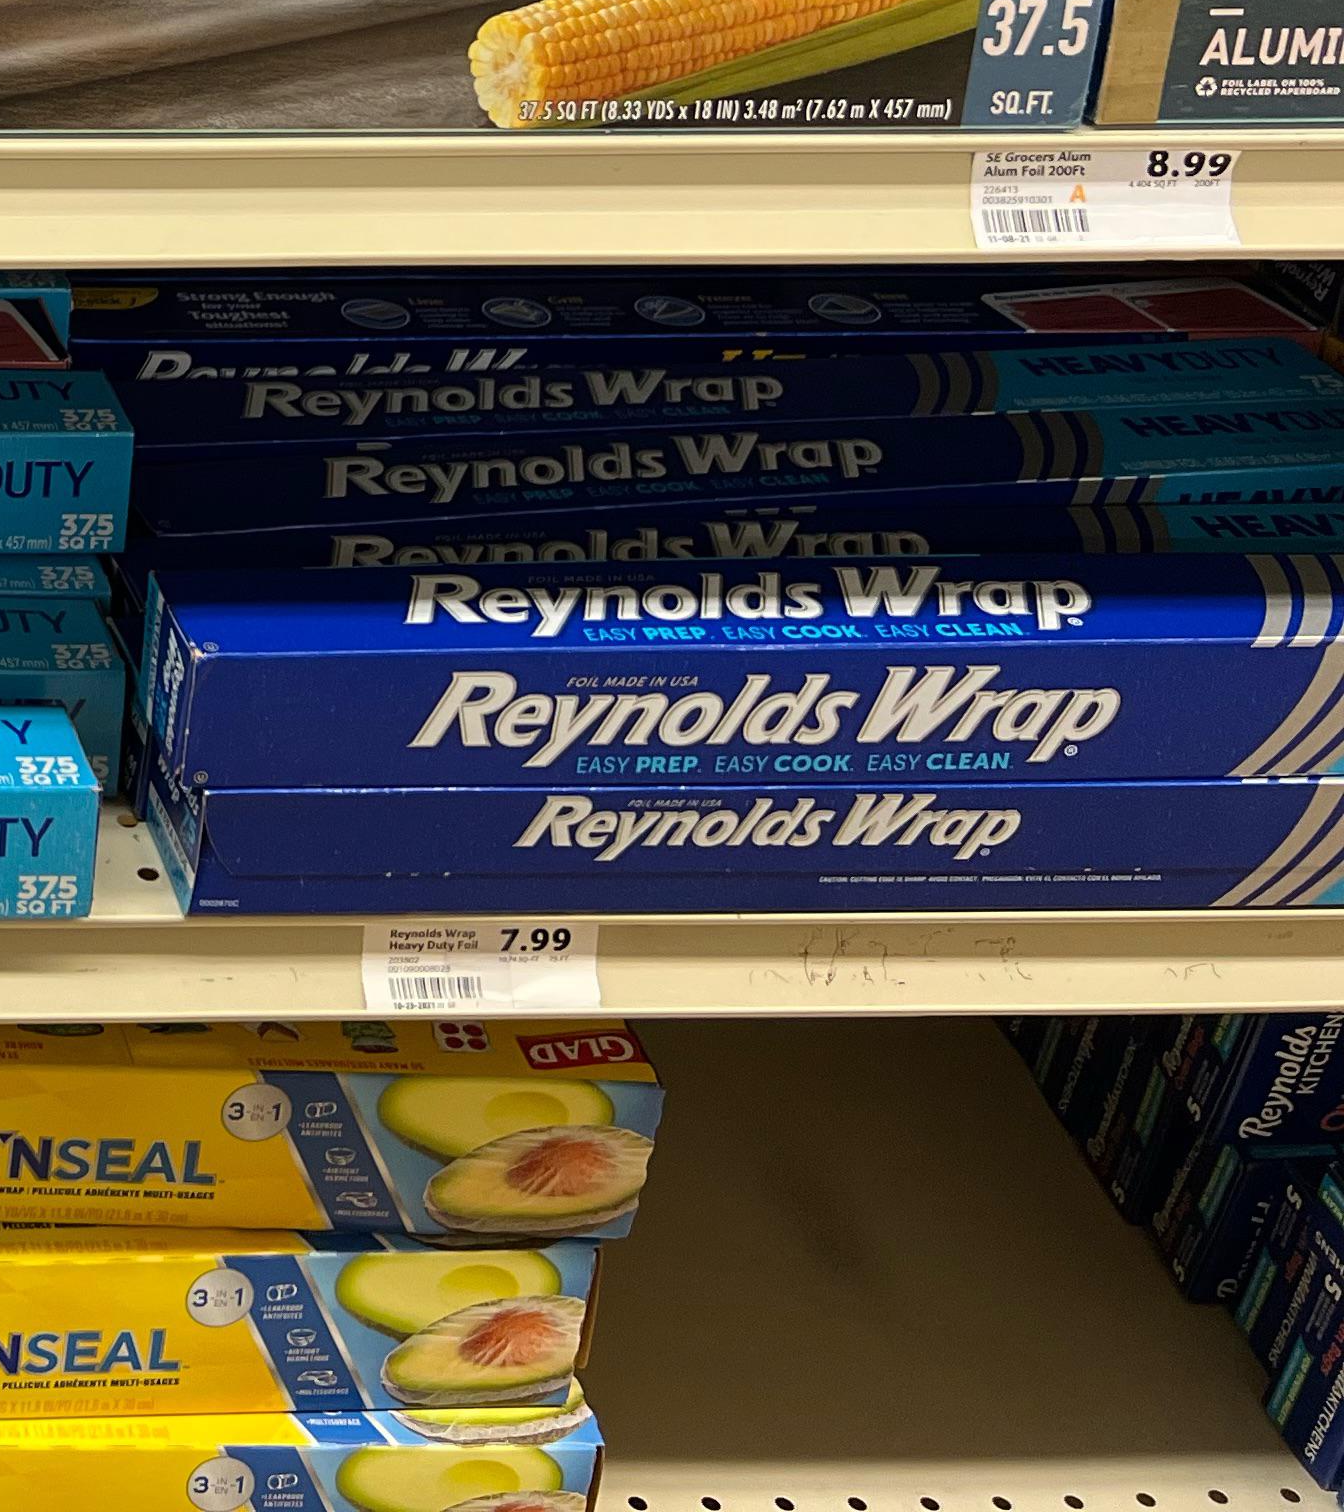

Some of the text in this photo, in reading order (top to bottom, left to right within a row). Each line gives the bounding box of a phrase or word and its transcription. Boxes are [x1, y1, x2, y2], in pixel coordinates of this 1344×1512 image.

[519, 99, 779, 123] 37.5 SQ FT (8.33 YDS x 18 IN) 3.48
[990, 91, 1054, 115] SQ.FT.
[985, 151, 1092, 164] SE Grocers Alum
[1146, 150, 1233, 179] 8.99
[983, 165, 1086, 178] Alum Foil 200Ft
[406, 664, 1121, 769] Reynolds Wrap
[389, 940, 479, 953] Heavy Duty Foil
[390, 928, 477, 941] Reynolds Wrap
[500, 927, 572, 953] 7.99
[1239, 1025, 1317, 1139] Reynolds
